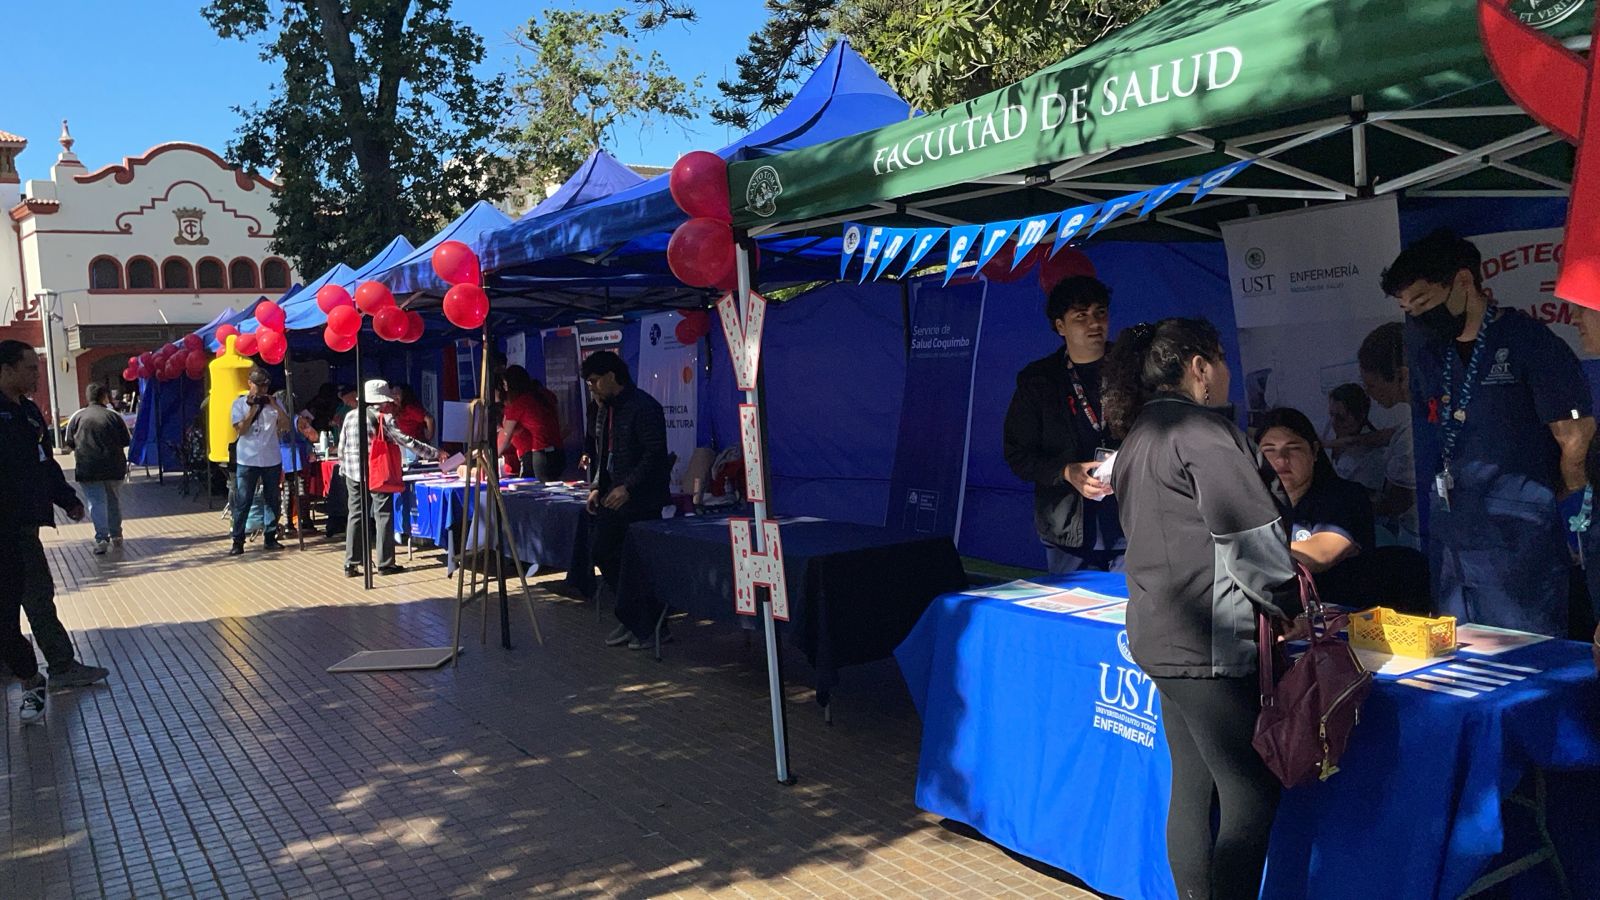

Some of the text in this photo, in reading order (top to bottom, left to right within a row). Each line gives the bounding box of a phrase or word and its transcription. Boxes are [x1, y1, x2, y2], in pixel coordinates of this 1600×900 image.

[1538, 0, 1572, 19] VERI
[873, 46, 1244, 176] FACULTAD DE SALUD
[1482, 242, 1563, 279] DETEC
[1290, 262, 1359, 283] ENFERMERÍA
[1241, 274, 1276, 294] UST
[912, 336, 970, 350] Salud Coquimbo
[663, 405, 688, 414] TRICIA
[666, 419, 694, 428] ULTURA
[1093, 715, 1154, 750] ENFERMERÍA
